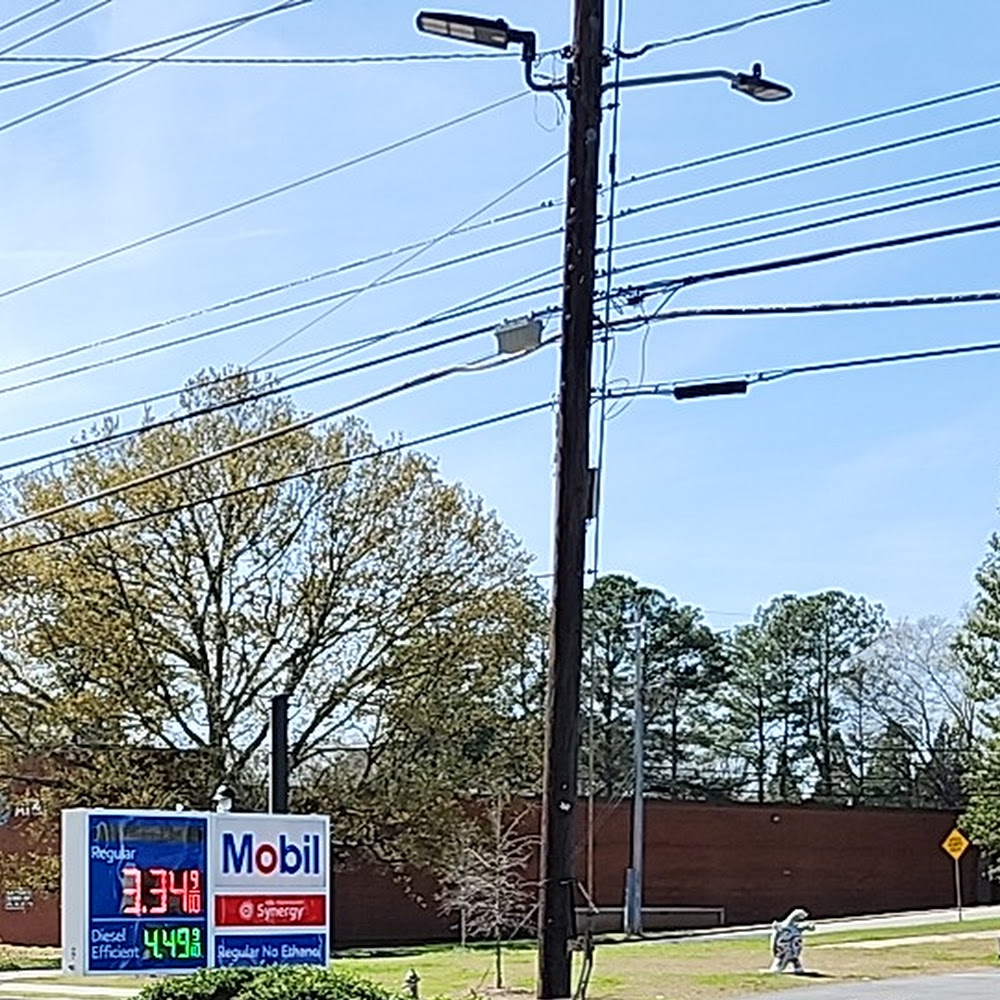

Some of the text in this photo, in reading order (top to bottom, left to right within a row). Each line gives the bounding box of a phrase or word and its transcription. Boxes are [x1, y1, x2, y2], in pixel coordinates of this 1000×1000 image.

[91, 845, 136, 863] Regular
[223, 832, 319, 876] Mobil
[256, 903, 306, 921] Synergy
[91, 928, 127, 942] Diesel
[91, 944, 140, 959] Efficient
[217, 943, 322, 962] Regular No Ethanol
